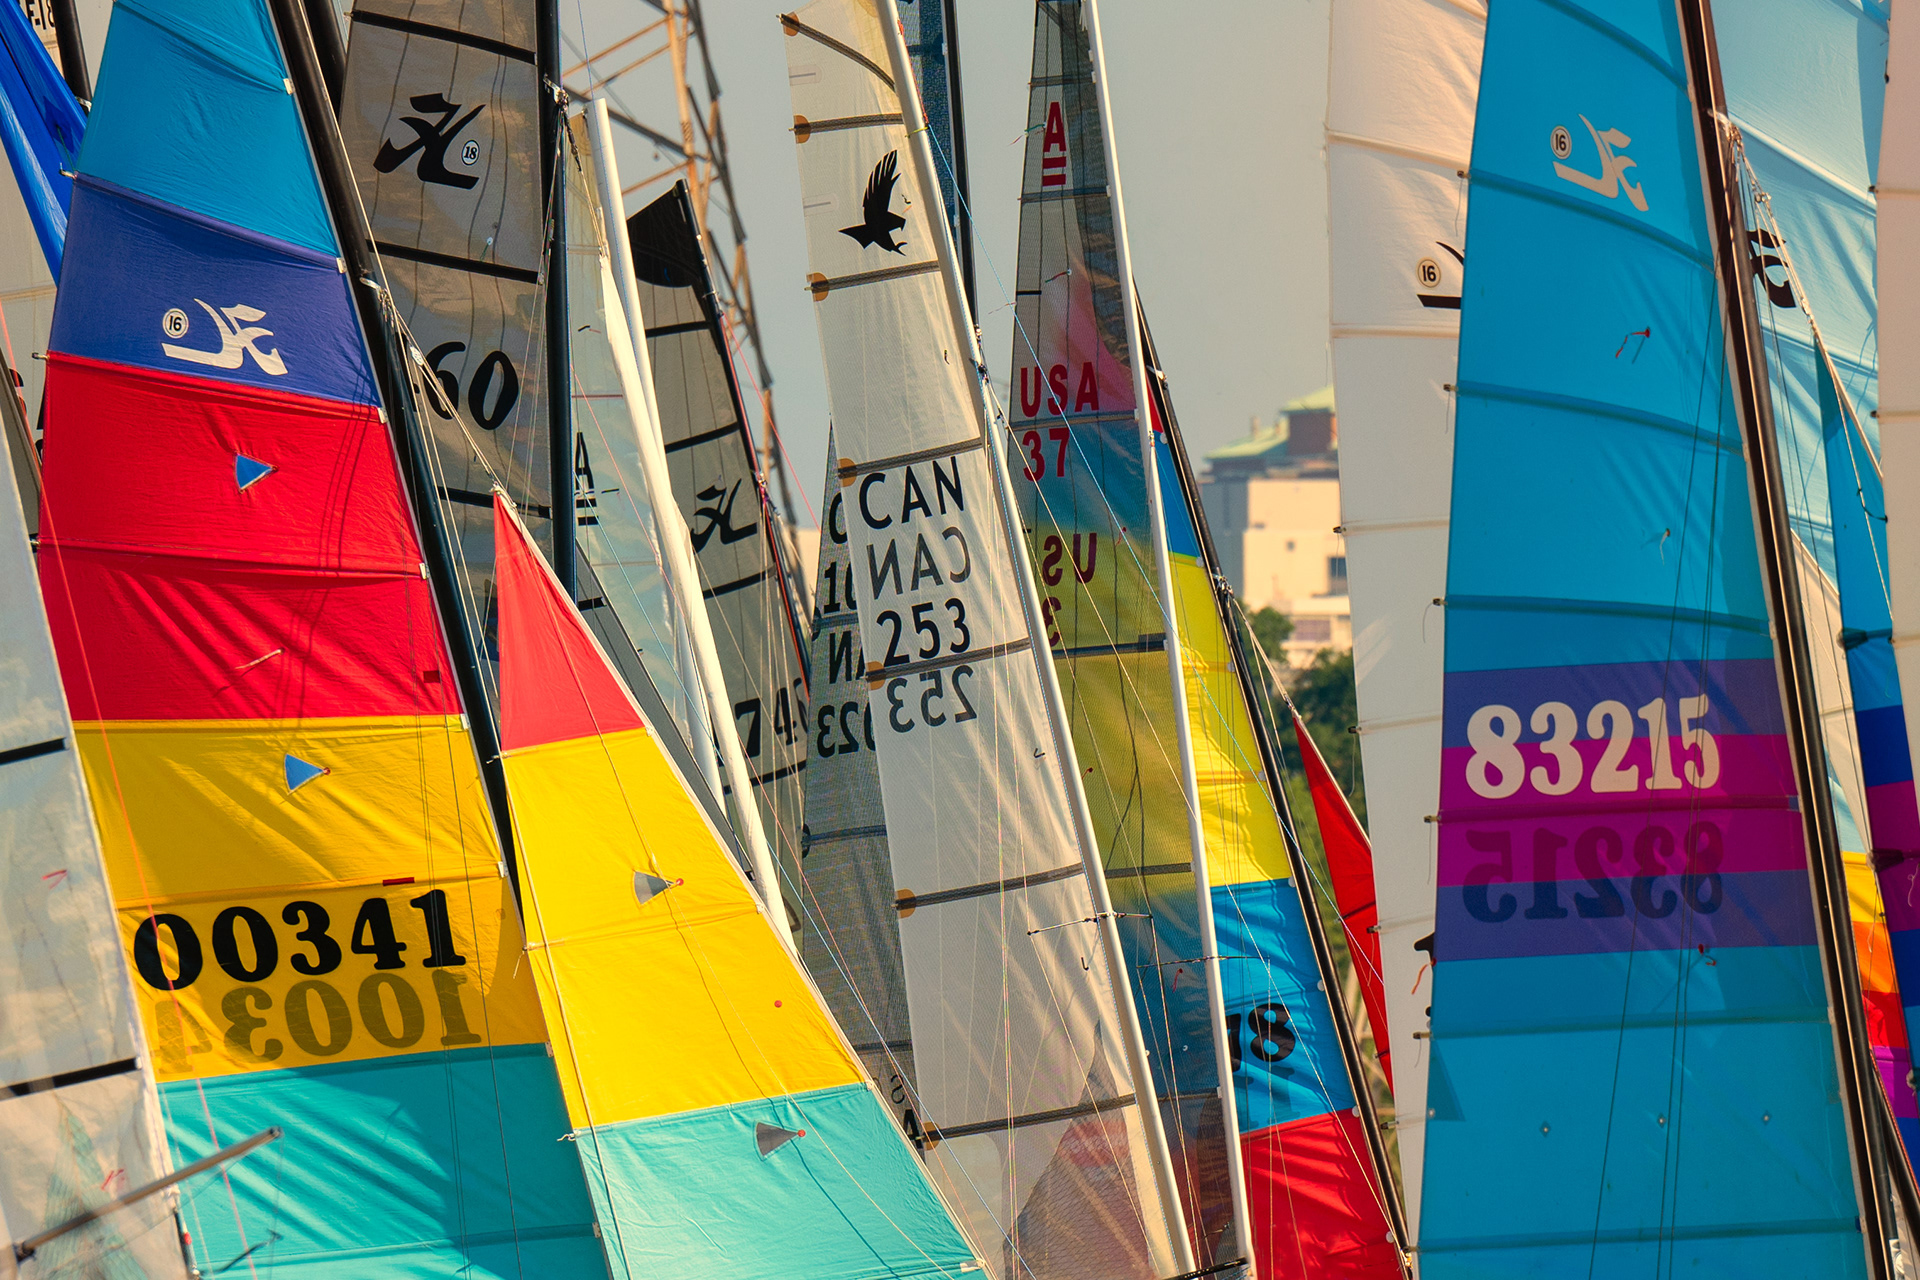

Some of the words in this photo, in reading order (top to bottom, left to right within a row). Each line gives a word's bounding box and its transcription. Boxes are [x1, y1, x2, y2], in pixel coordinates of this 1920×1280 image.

[464, 146, 477, 160] 18
[1042, 102, 1067, 152] A
[1555, 133, 1567, 151] 16
[1422, 264, 1437, 282] 16
[168, 315, 182, 332] 16
[411, 341, 519, 430] 60
[1020, 361, 1099, 418] USA
[1022, 427, 1070, 482] 37
[858, 455, 965, 530] CAN
[876, 598, 971, 668] 253
[711, 677, 808, 767] 74
[1465, 693, 1720, 799] 83215
[134, 889, 467, 991] 00341
